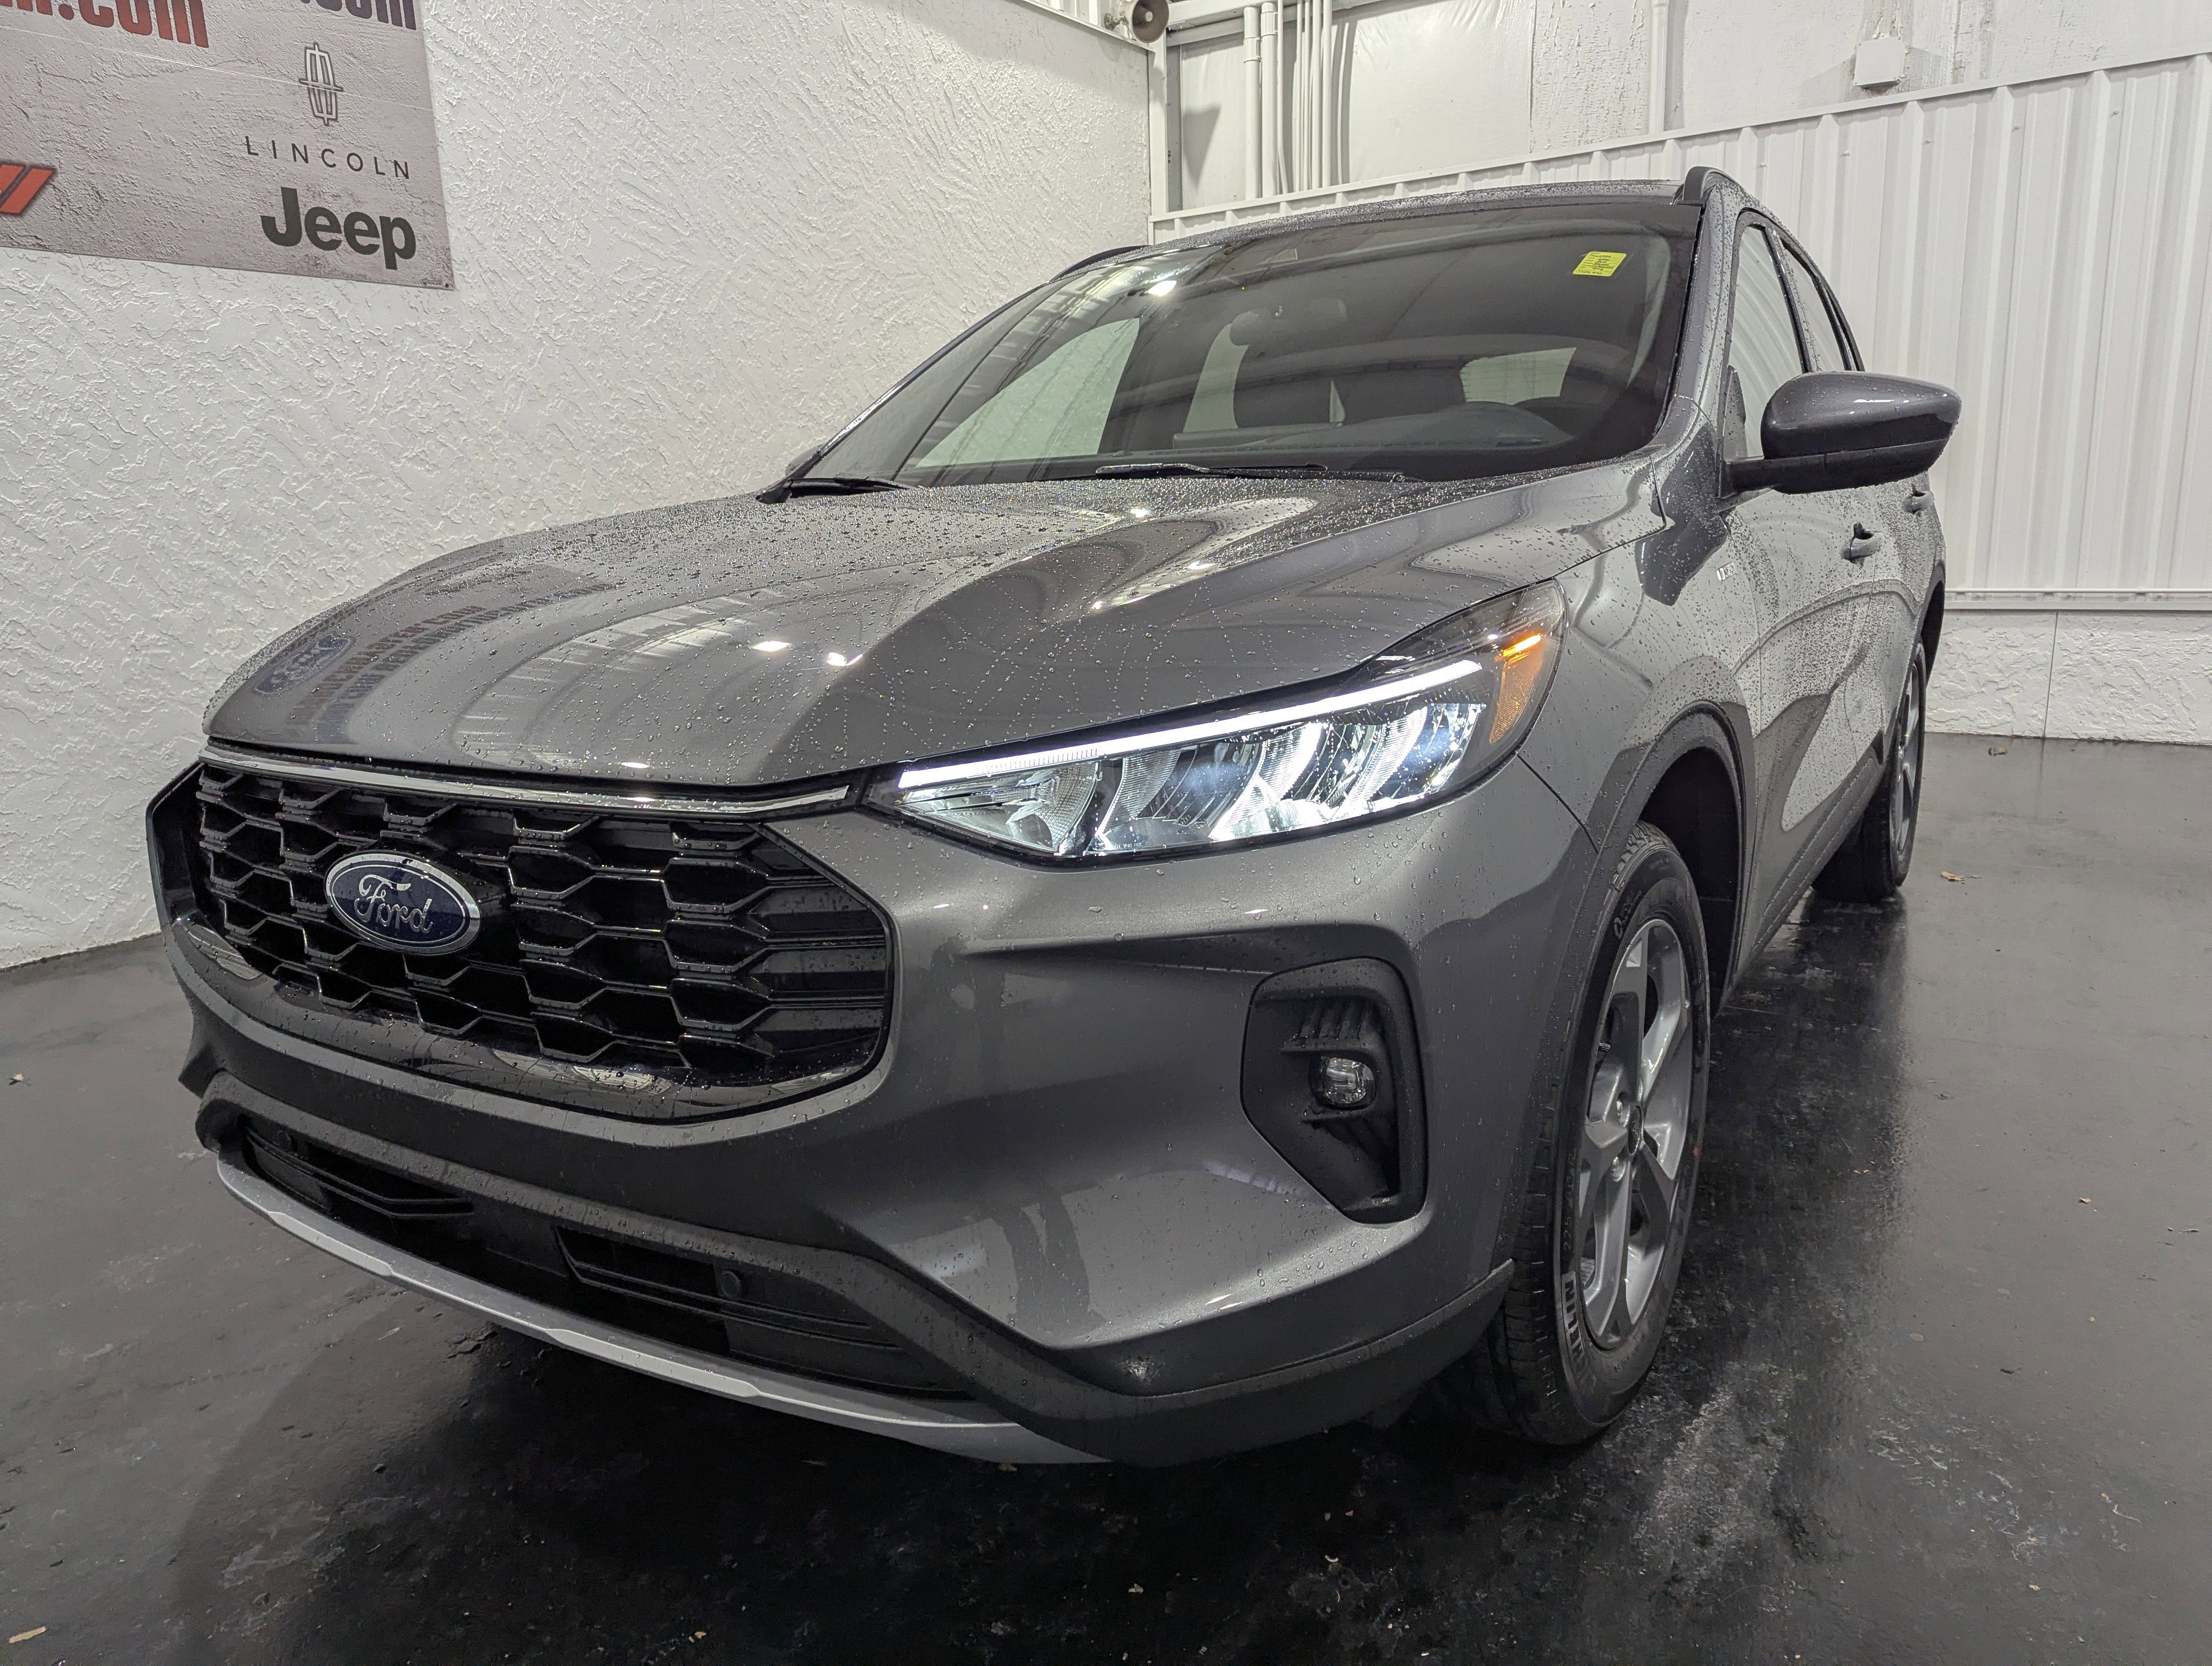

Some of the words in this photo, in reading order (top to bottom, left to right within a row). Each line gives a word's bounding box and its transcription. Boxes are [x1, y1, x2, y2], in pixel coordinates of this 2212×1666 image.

[245, 136, 409, 179] LINCOLN
[260, 187, 416, 270] Jeep
[354, 874, 433, 933] Ford
